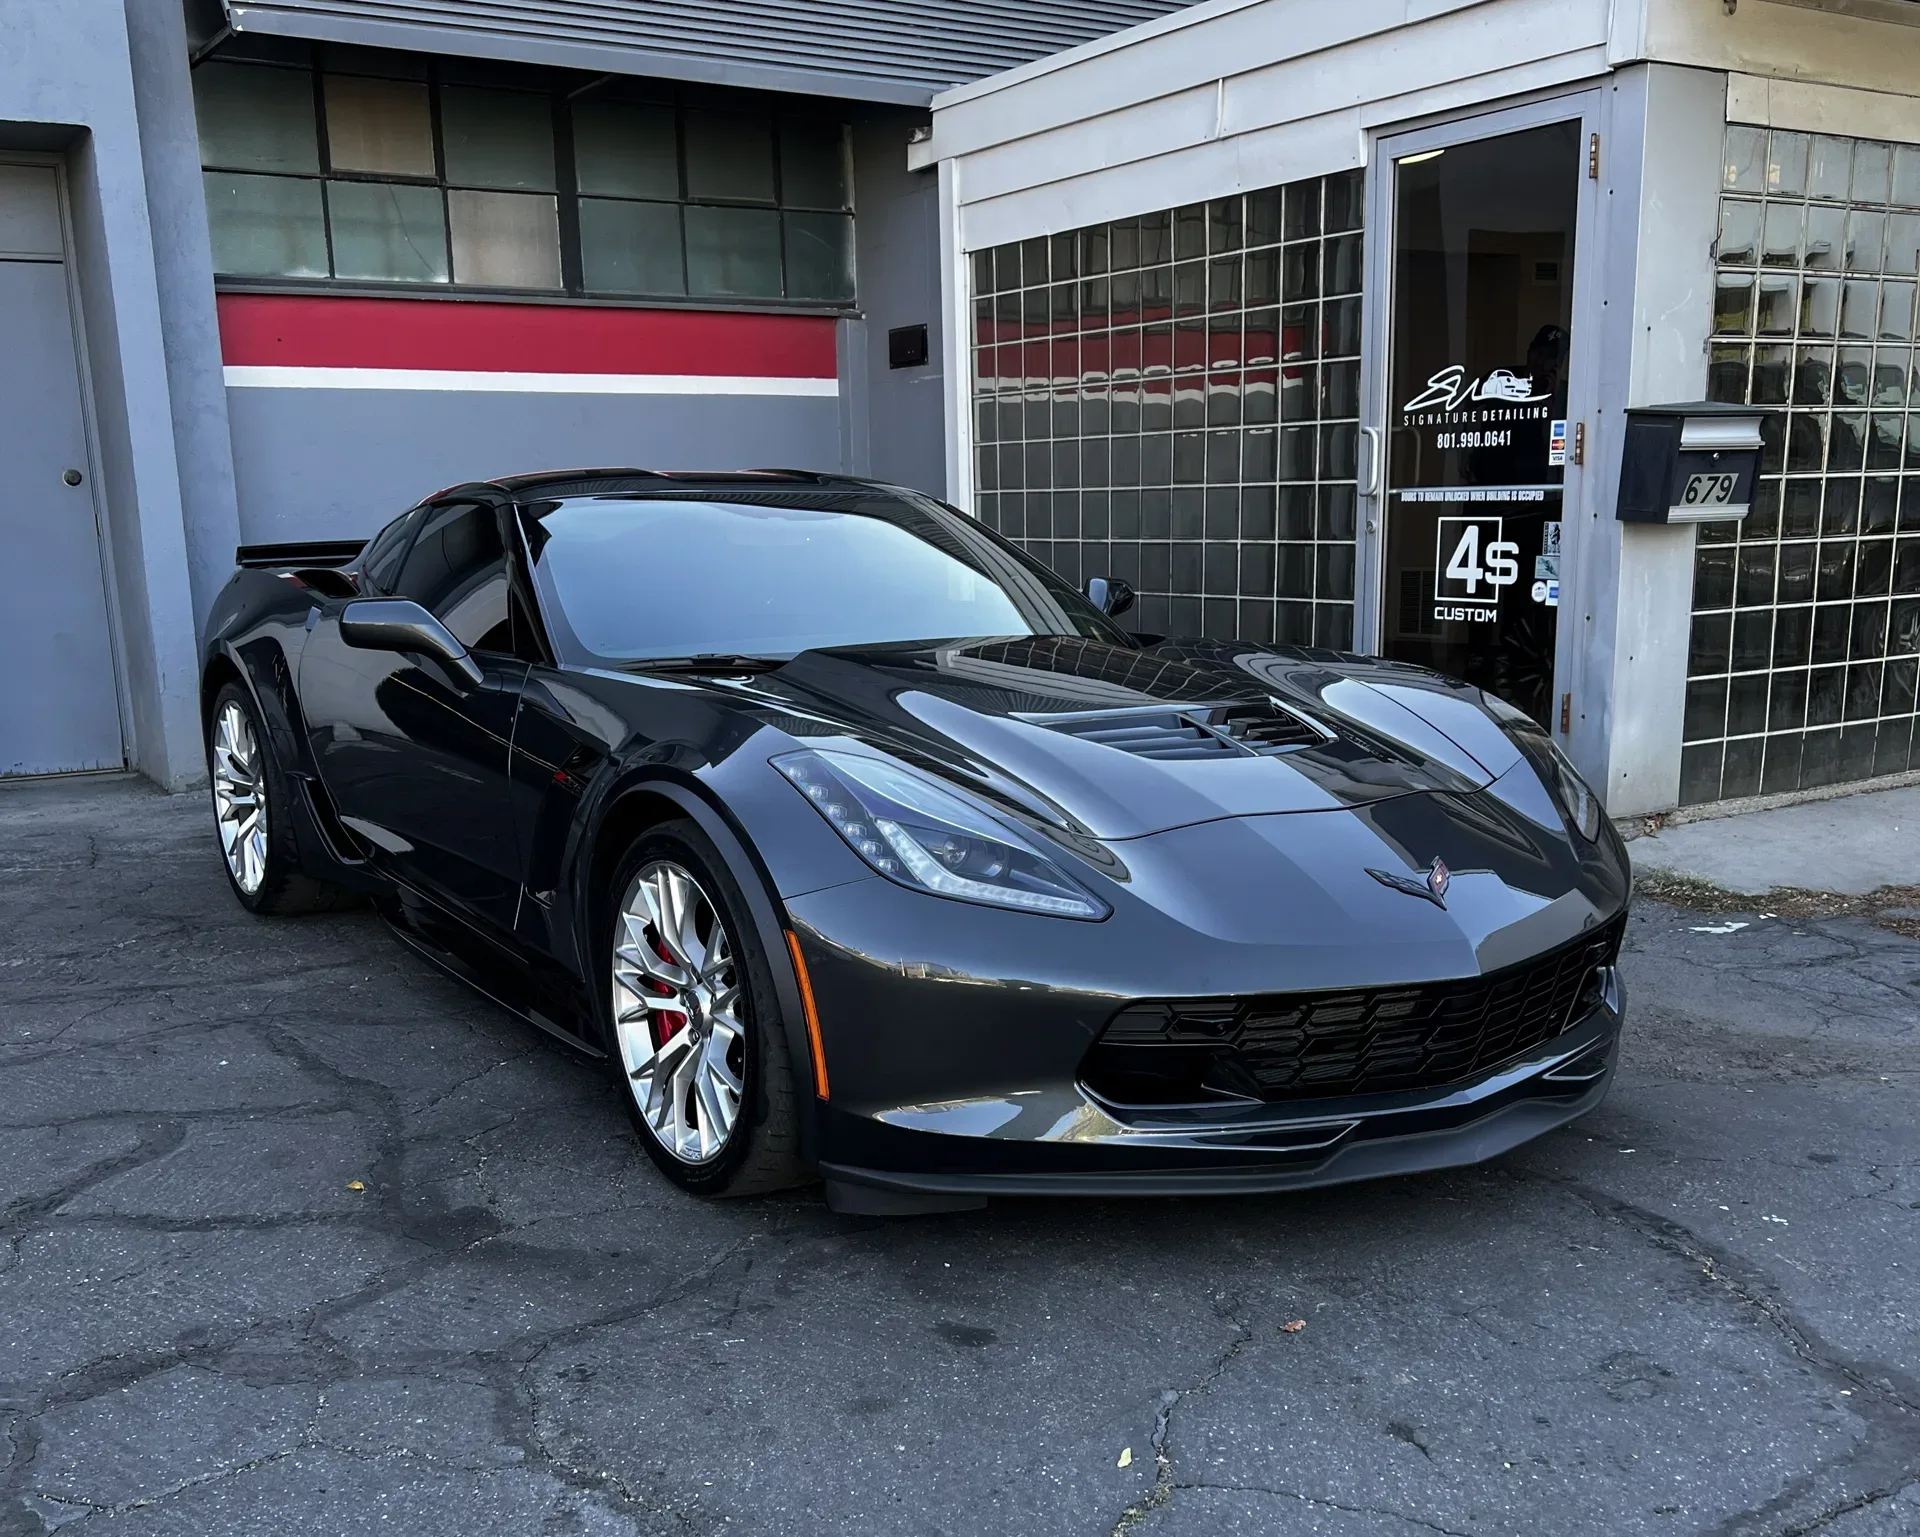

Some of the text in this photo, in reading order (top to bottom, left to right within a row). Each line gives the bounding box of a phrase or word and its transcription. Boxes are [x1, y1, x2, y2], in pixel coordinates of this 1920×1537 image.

[1403, 407, 1549, 426] SIGNATURE DETAILING
[1437, 430, 1511, 449] 801.990.0641
[1424, 491, 1444, 502] REMAIN
[1445, 491, 1470, 502] UNLOCKED
[1470, 491, 1485, 501] WHEN
[1486, 490, 1510, 501] BUILDING
[1518, 490, 1544, 501] OCCUPIED
[1685, 475, 1733, 505] 679
[1434, 607, 1497, 623] CUSTOM
